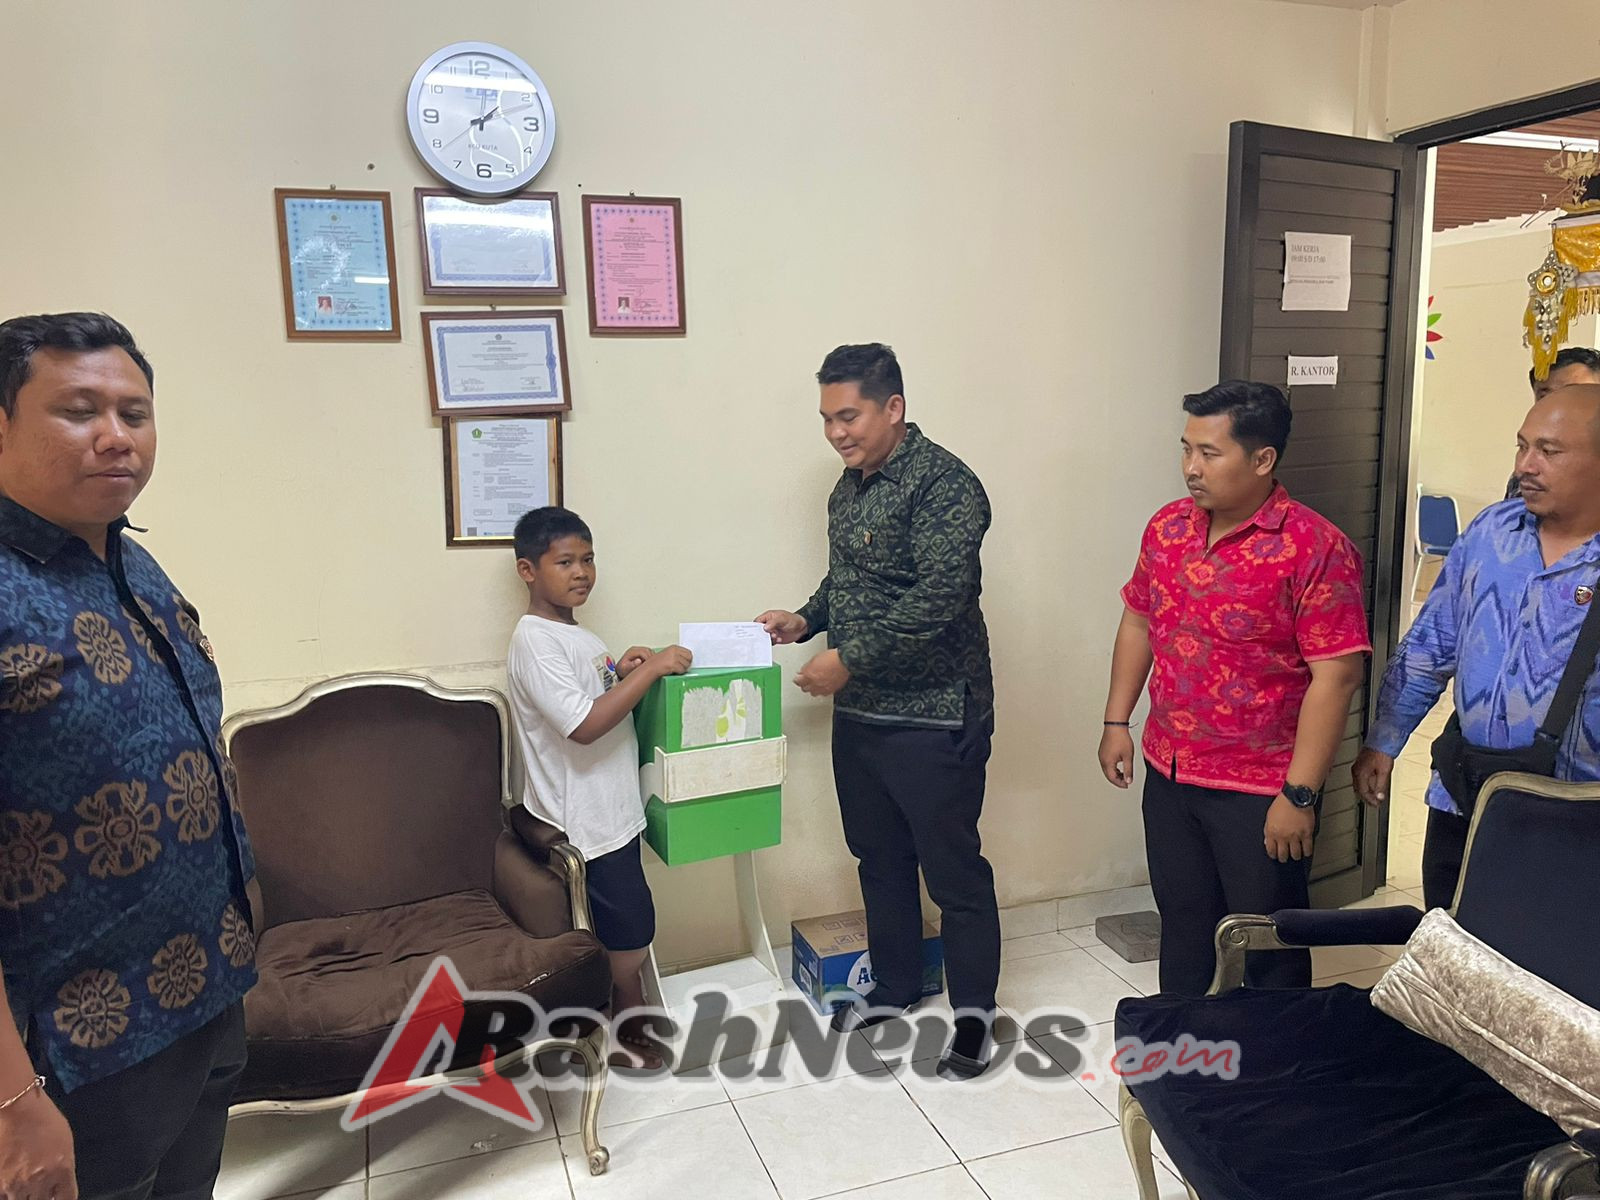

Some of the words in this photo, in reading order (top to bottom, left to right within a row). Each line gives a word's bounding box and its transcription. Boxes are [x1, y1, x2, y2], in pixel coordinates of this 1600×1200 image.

[468, 60, 491, 77] 12
[430, 84, 444, 94] 10
[521, 92, 531, 102] 2
[423, 108, 439, 124] 9
[523, 117, 539, 132] 3
[432, 138, 442, 149] 8
[523, 146, 532, 155] 4
[453, 160, 462, 169] 7
[505, 164, 515, 173] 5
[476, 163, 492, 178] 6
[1301, 366, 1335, 376] KANTOR
